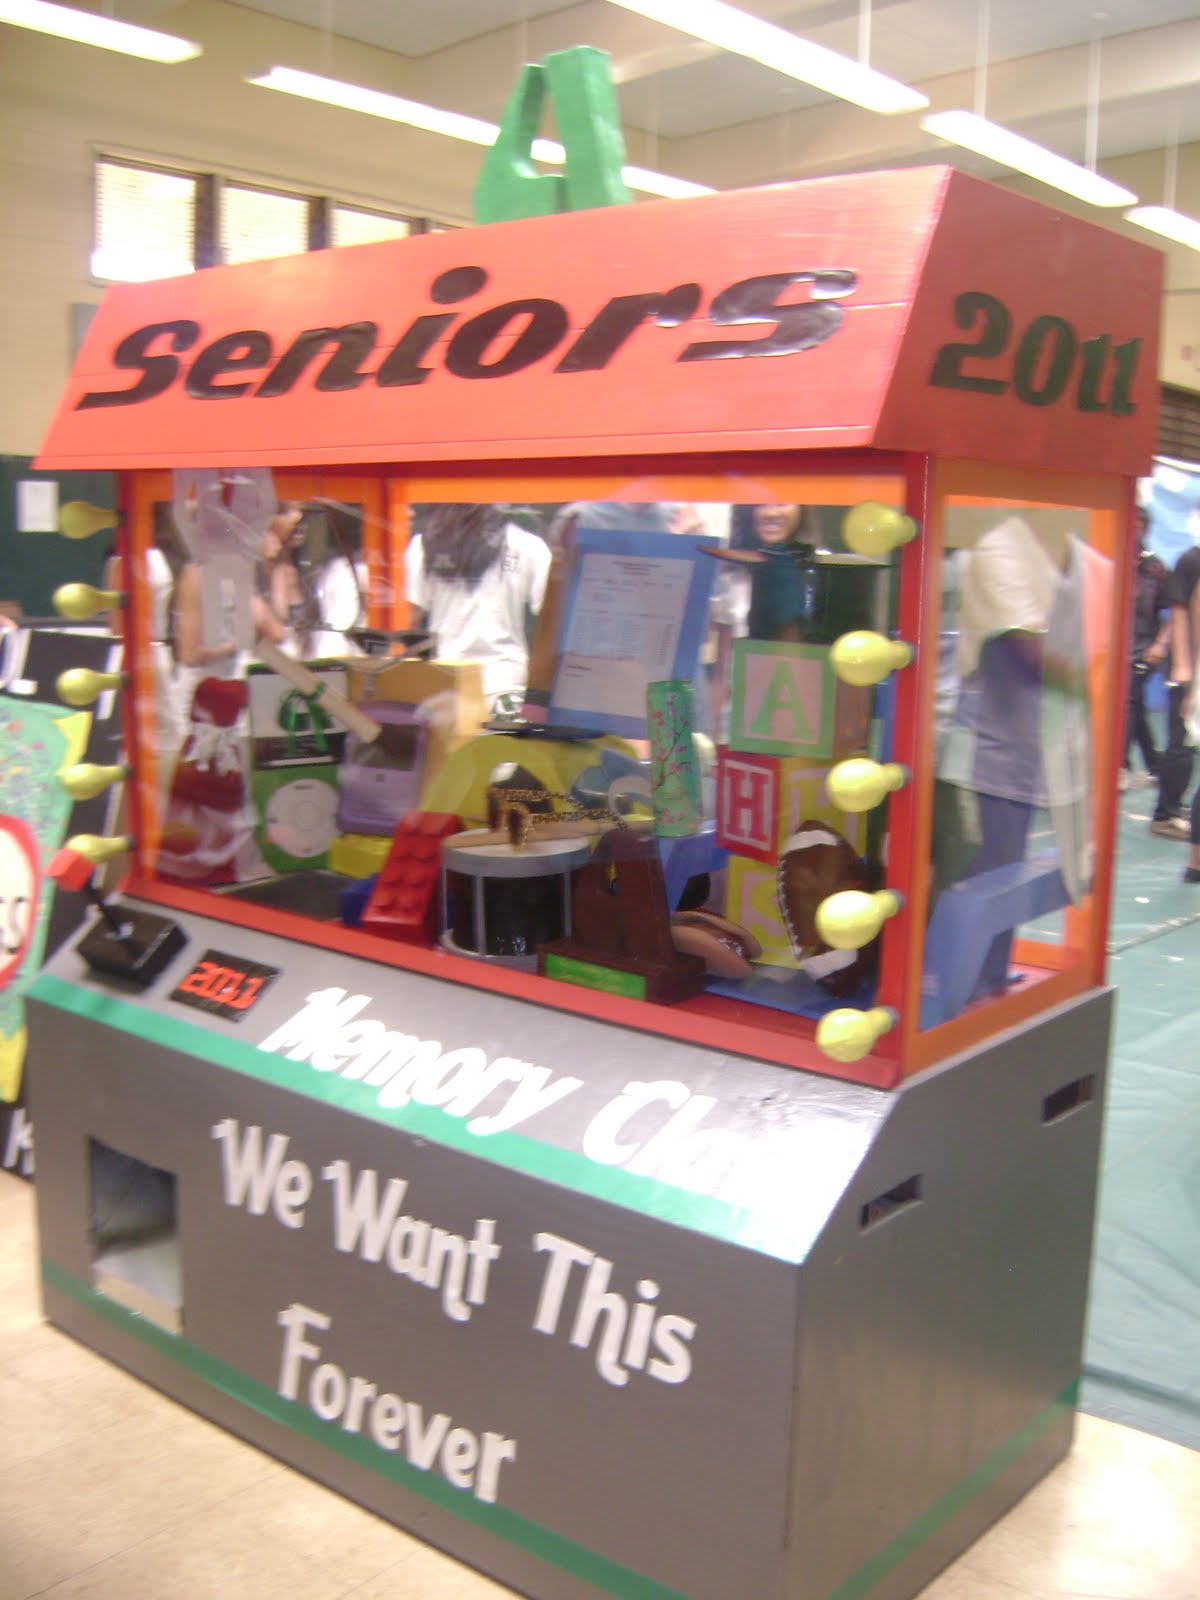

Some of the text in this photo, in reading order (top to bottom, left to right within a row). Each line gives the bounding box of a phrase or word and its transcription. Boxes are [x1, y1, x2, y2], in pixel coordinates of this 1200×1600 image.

[74, 266, 858, 410] Seniors
[928, 291, 1144, 416] 2011
[751, 660, 817, 740] A
[725, 764, 769, 843] H
[258, 986, 790, 1205] Memory Cla
[213, 1118, 696, 1387] We Want This
[278, 1303, 516, 1503] Forever
